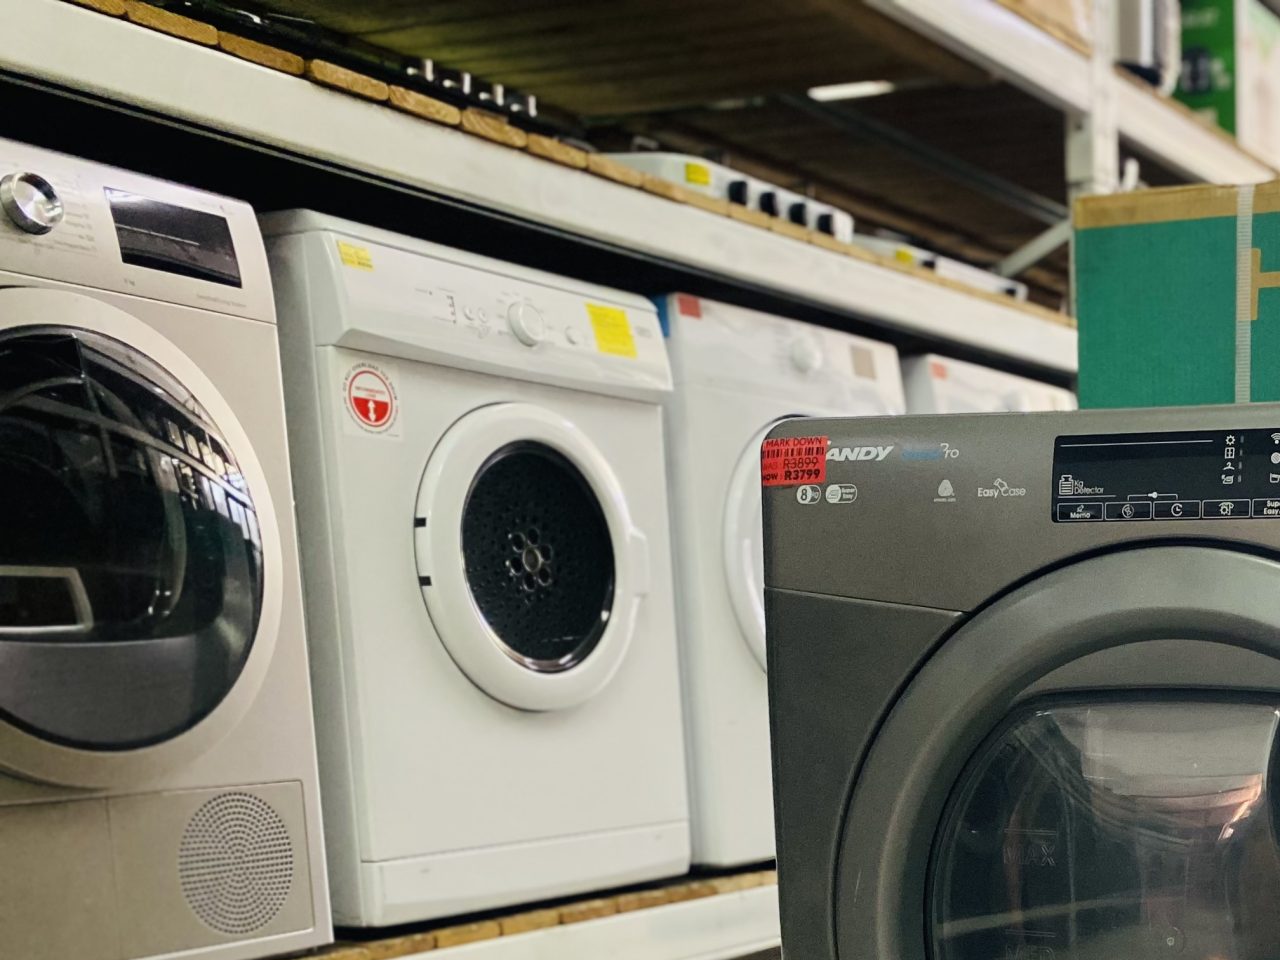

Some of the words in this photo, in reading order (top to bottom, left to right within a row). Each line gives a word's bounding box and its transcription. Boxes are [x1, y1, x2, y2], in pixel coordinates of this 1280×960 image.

[766, 438, 791, 447] MARK
[793, 436, 822, 446] DOWN
[826, 441, 895, 461] ANDY
[784, 468, 820, 481] R3799
[800, 488, 808, 501] 8
[977, 487, 999, 498] Easy
[1264, 507, 1279, 515] Easy
[1003, 844, 1056, 866] MAX
